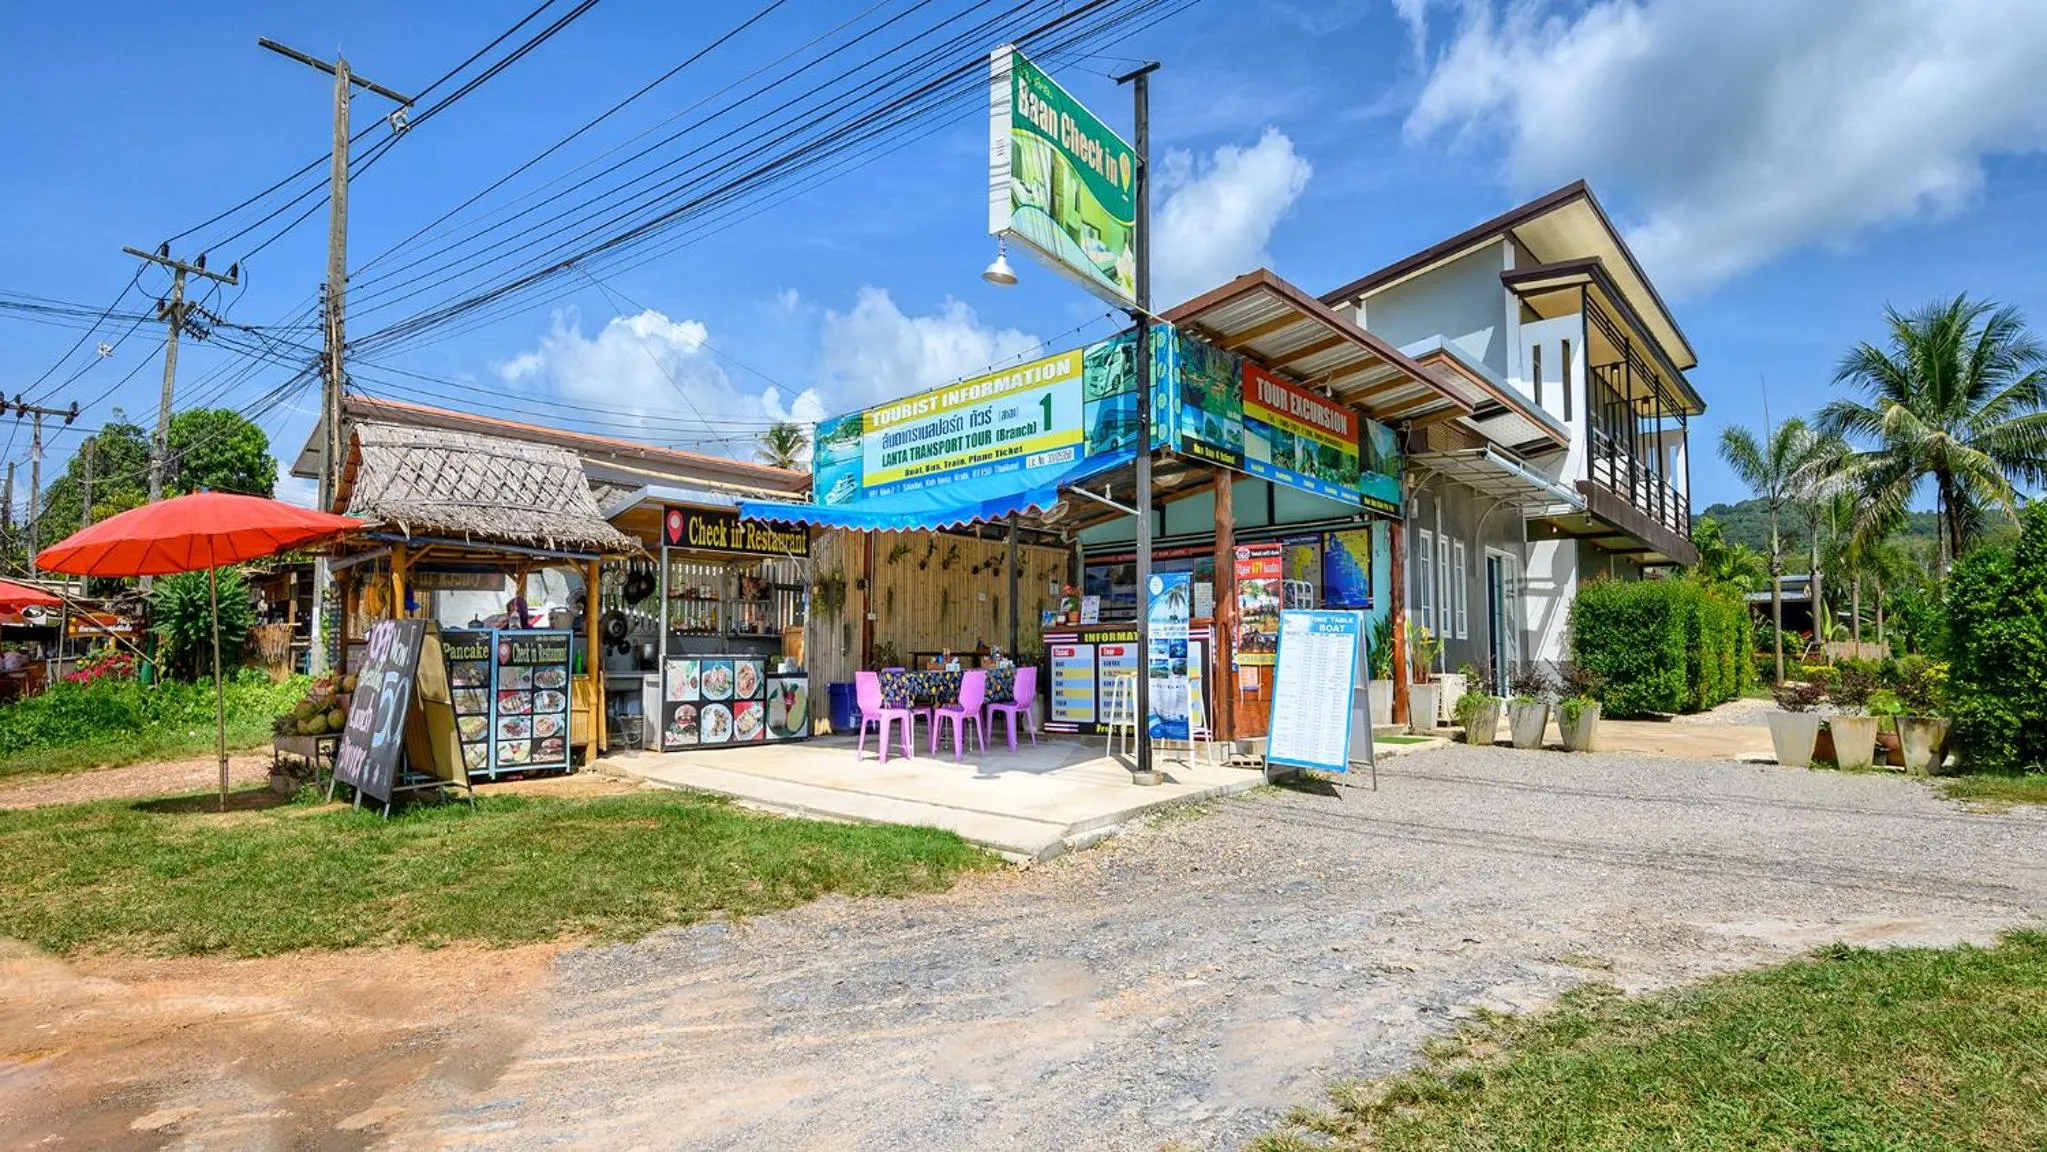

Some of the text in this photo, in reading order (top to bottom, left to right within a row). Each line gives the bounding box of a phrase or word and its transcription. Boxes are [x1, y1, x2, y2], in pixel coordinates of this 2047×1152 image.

[1018, 76, 1059, 140] Baan
[1061, 112, 1103, 176] Check
[1104, 147, 1118, 187] in
[872, 358, 1071, 427] TOURIST INFORMATION
[1256, 377, 1288, 411] TOUR
[1291, 393, 1347, 435] EXCURSION
[1039, 393, 1052, 431] 1
[882, 421, 1037, 468] LANTA TRANSPORT TOUR (Branch)
[995, 446, 1023, 458] Ticket
[688, 516, 806, 553] Check in Restaurant
[1319, 624, 1345, 632] BOAT
[1331, 616, 1354, 624] TABLE
[443, 641, 489, 659] Pancake
[1084, 631, 1139, 642] INFORMAT
[512, 643, 530, 663] Check
[538, 643, 568, 663] Restaurant
